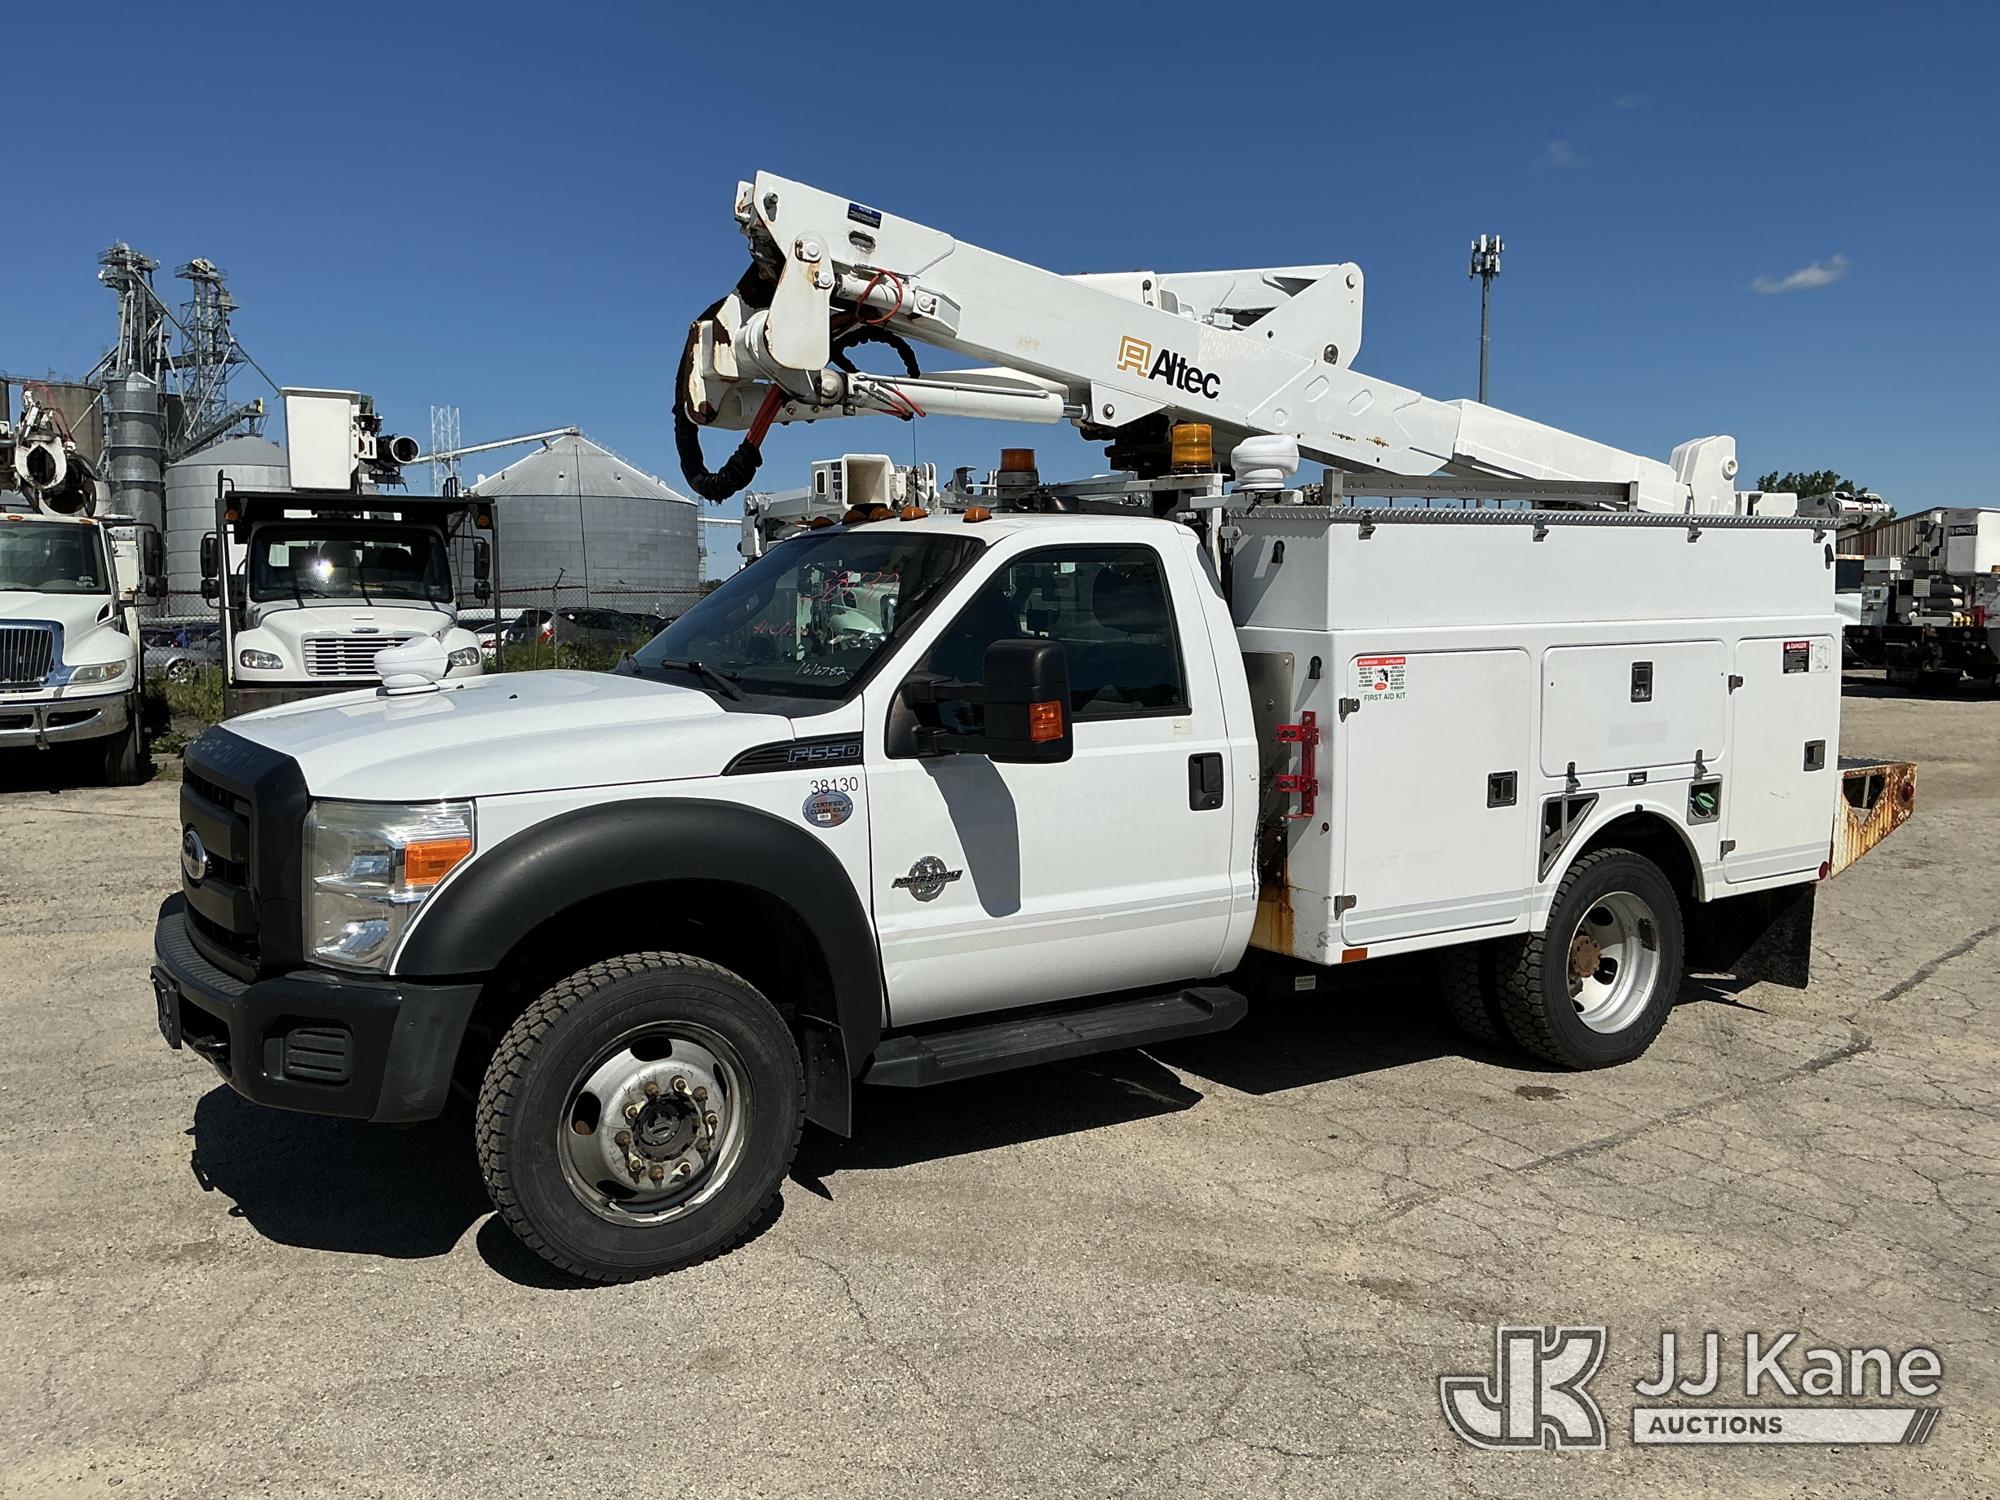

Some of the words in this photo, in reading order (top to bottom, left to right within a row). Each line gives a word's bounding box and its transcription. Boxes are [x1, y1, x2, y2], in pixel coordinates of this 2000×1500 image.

[1147, 348, 1221, 399] Altec
[1790, 642, 1807, 650] DANGER
[1363, 693, 1382, 701] FIRST
[1384, 692, 1395, 700] AID
[1396, 691, 1406, 699] KIT
[788, 744, 861, 762] F-550
[809, 776, 859, 795] 38130
[812, 800, 843, 809] CERTIFIED
[810, 807, 831, 815] CLEAN
[832, 805, 847, 813] IDLE
